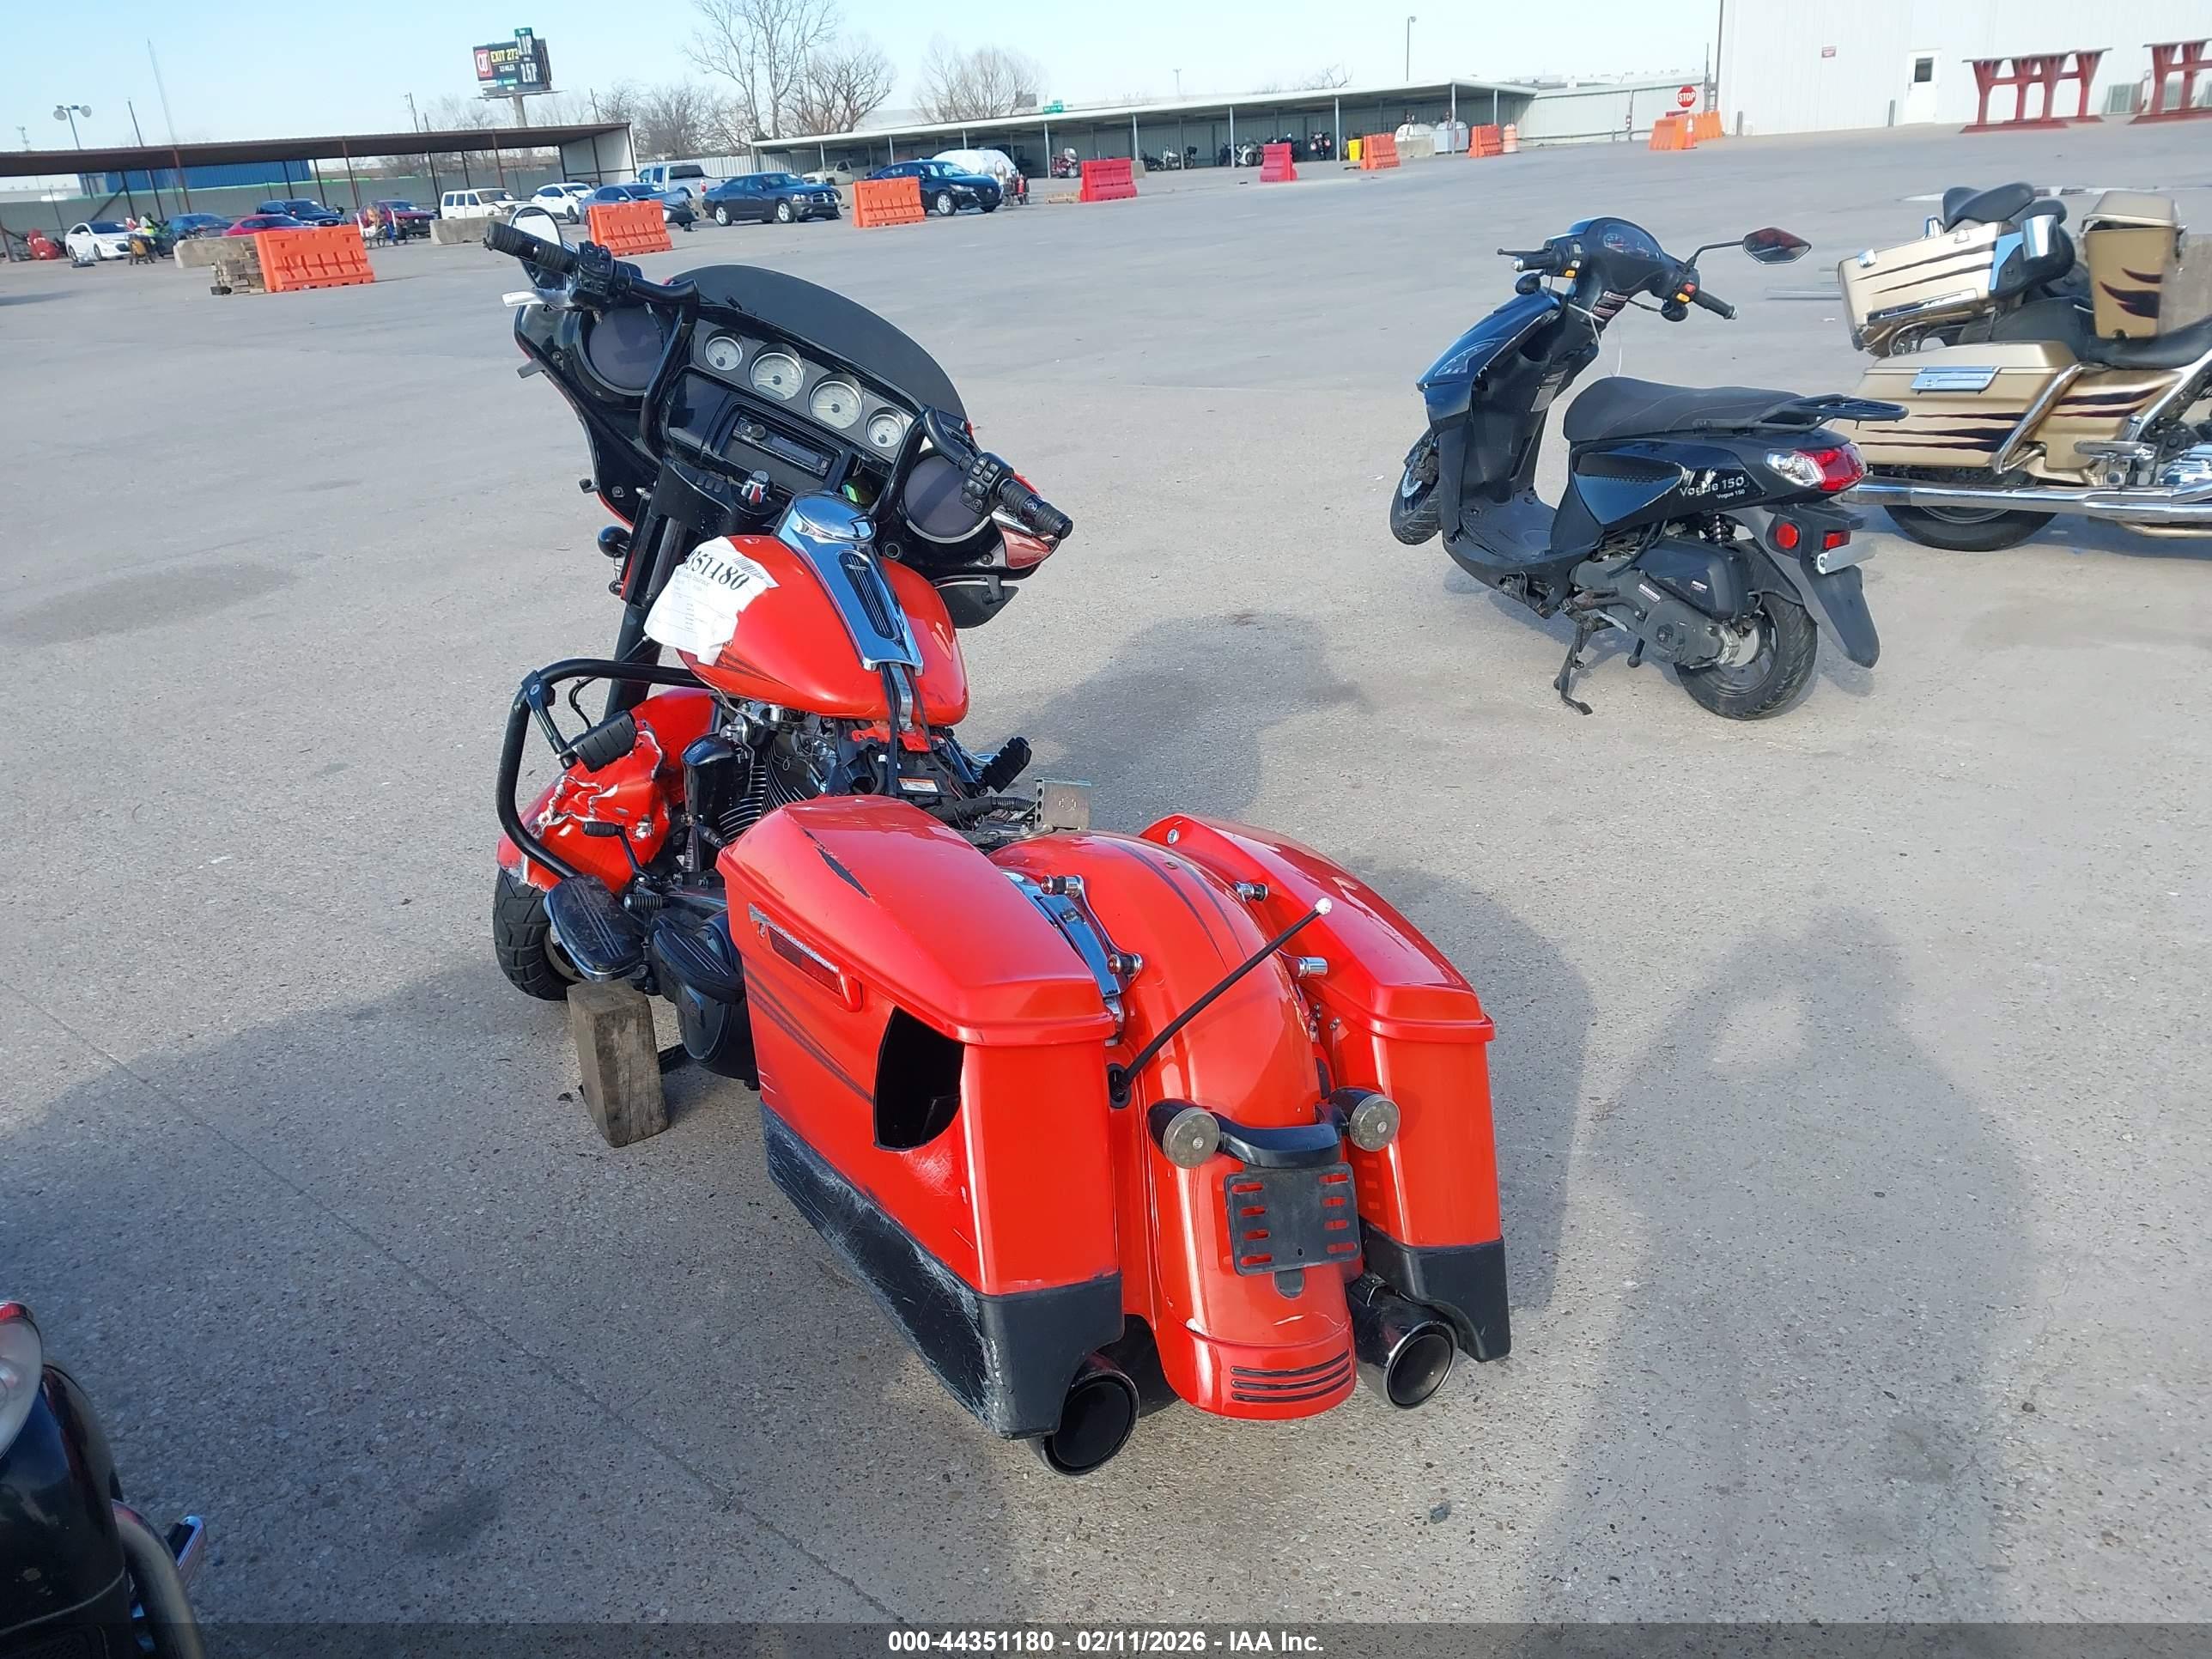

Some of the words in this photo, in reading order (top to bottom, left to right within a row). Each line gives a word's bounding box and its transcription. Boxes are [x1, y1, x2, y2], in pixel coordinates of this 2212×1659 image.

[490, 50, 505, 63] EXIT
[1679, 92, 1696, 102] STOP
[1679, 482, 1718, 496] Vogue
[1721, 475, 1745, 489] 150
